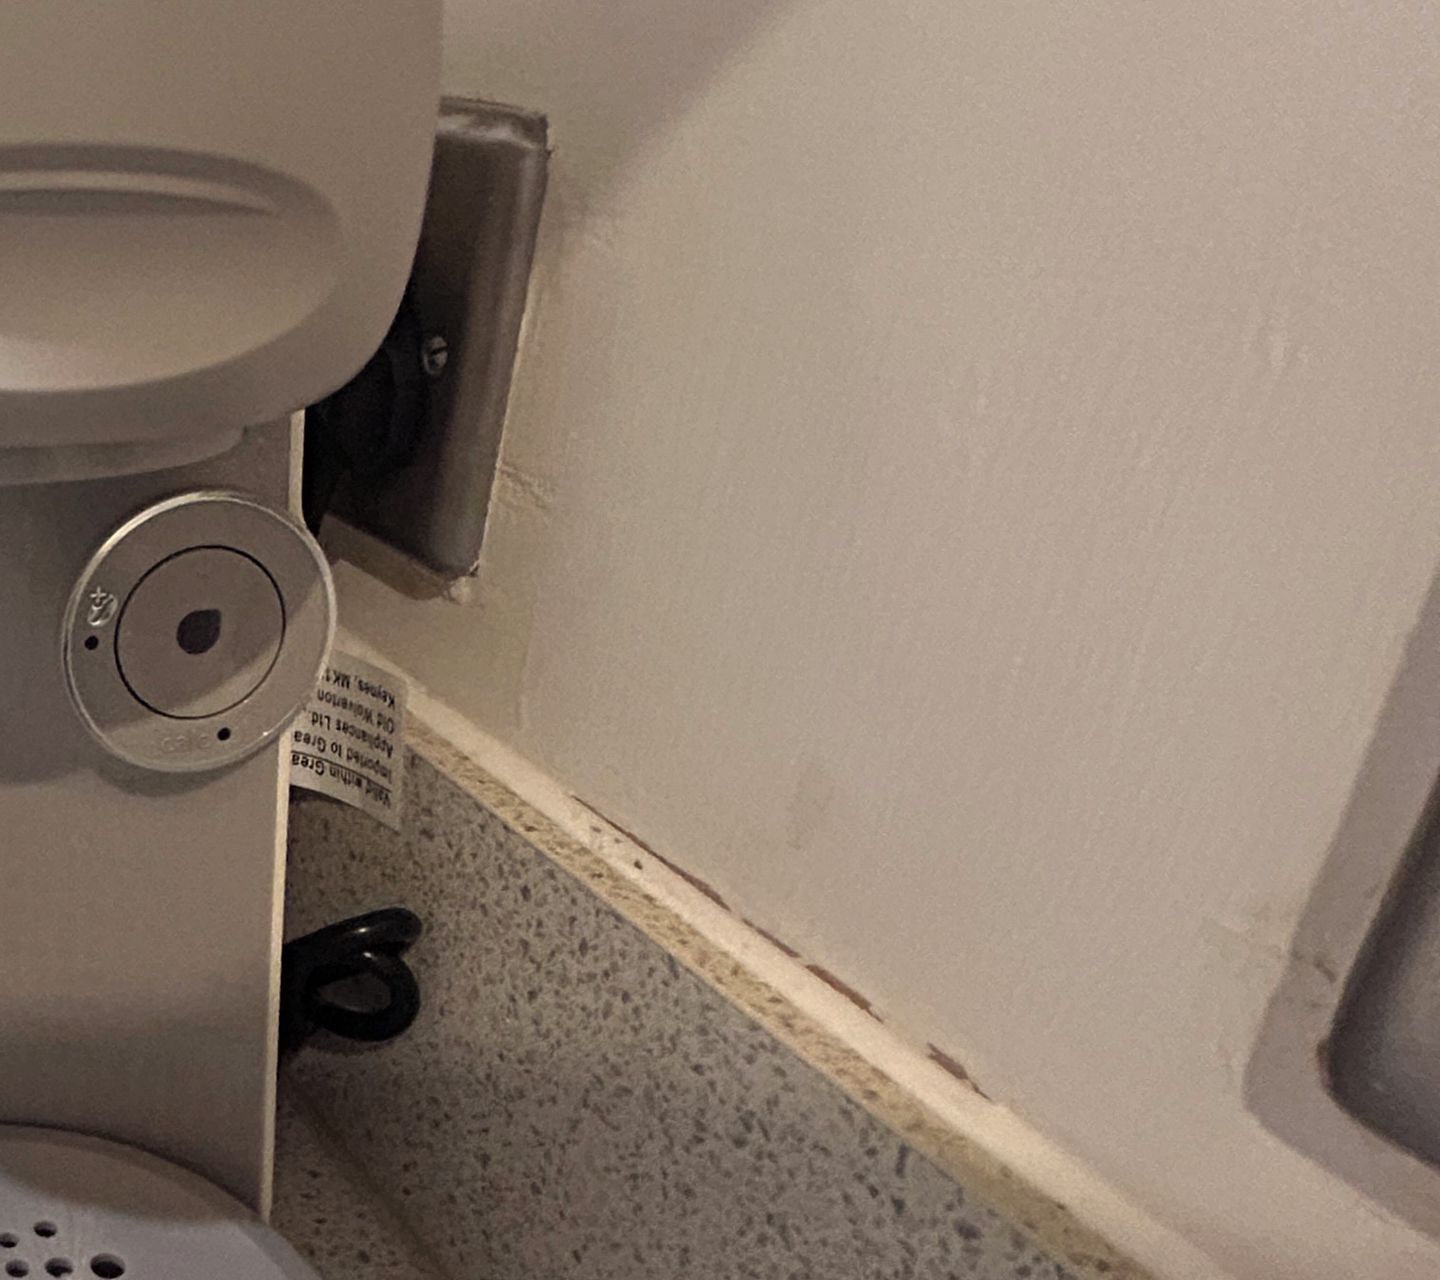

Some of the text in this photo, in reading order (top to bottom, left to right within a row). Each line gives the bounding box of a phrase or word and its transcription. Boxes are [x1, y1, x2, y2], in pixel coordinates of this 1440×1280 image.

[322, 666, 351, 690] MK1
[336, 719, 393, 759] Appliances
[291, 754, 325, 776] Grea
[293, 730, 393, 785] Imported to Grea
[329, 765, 363, 788] within
